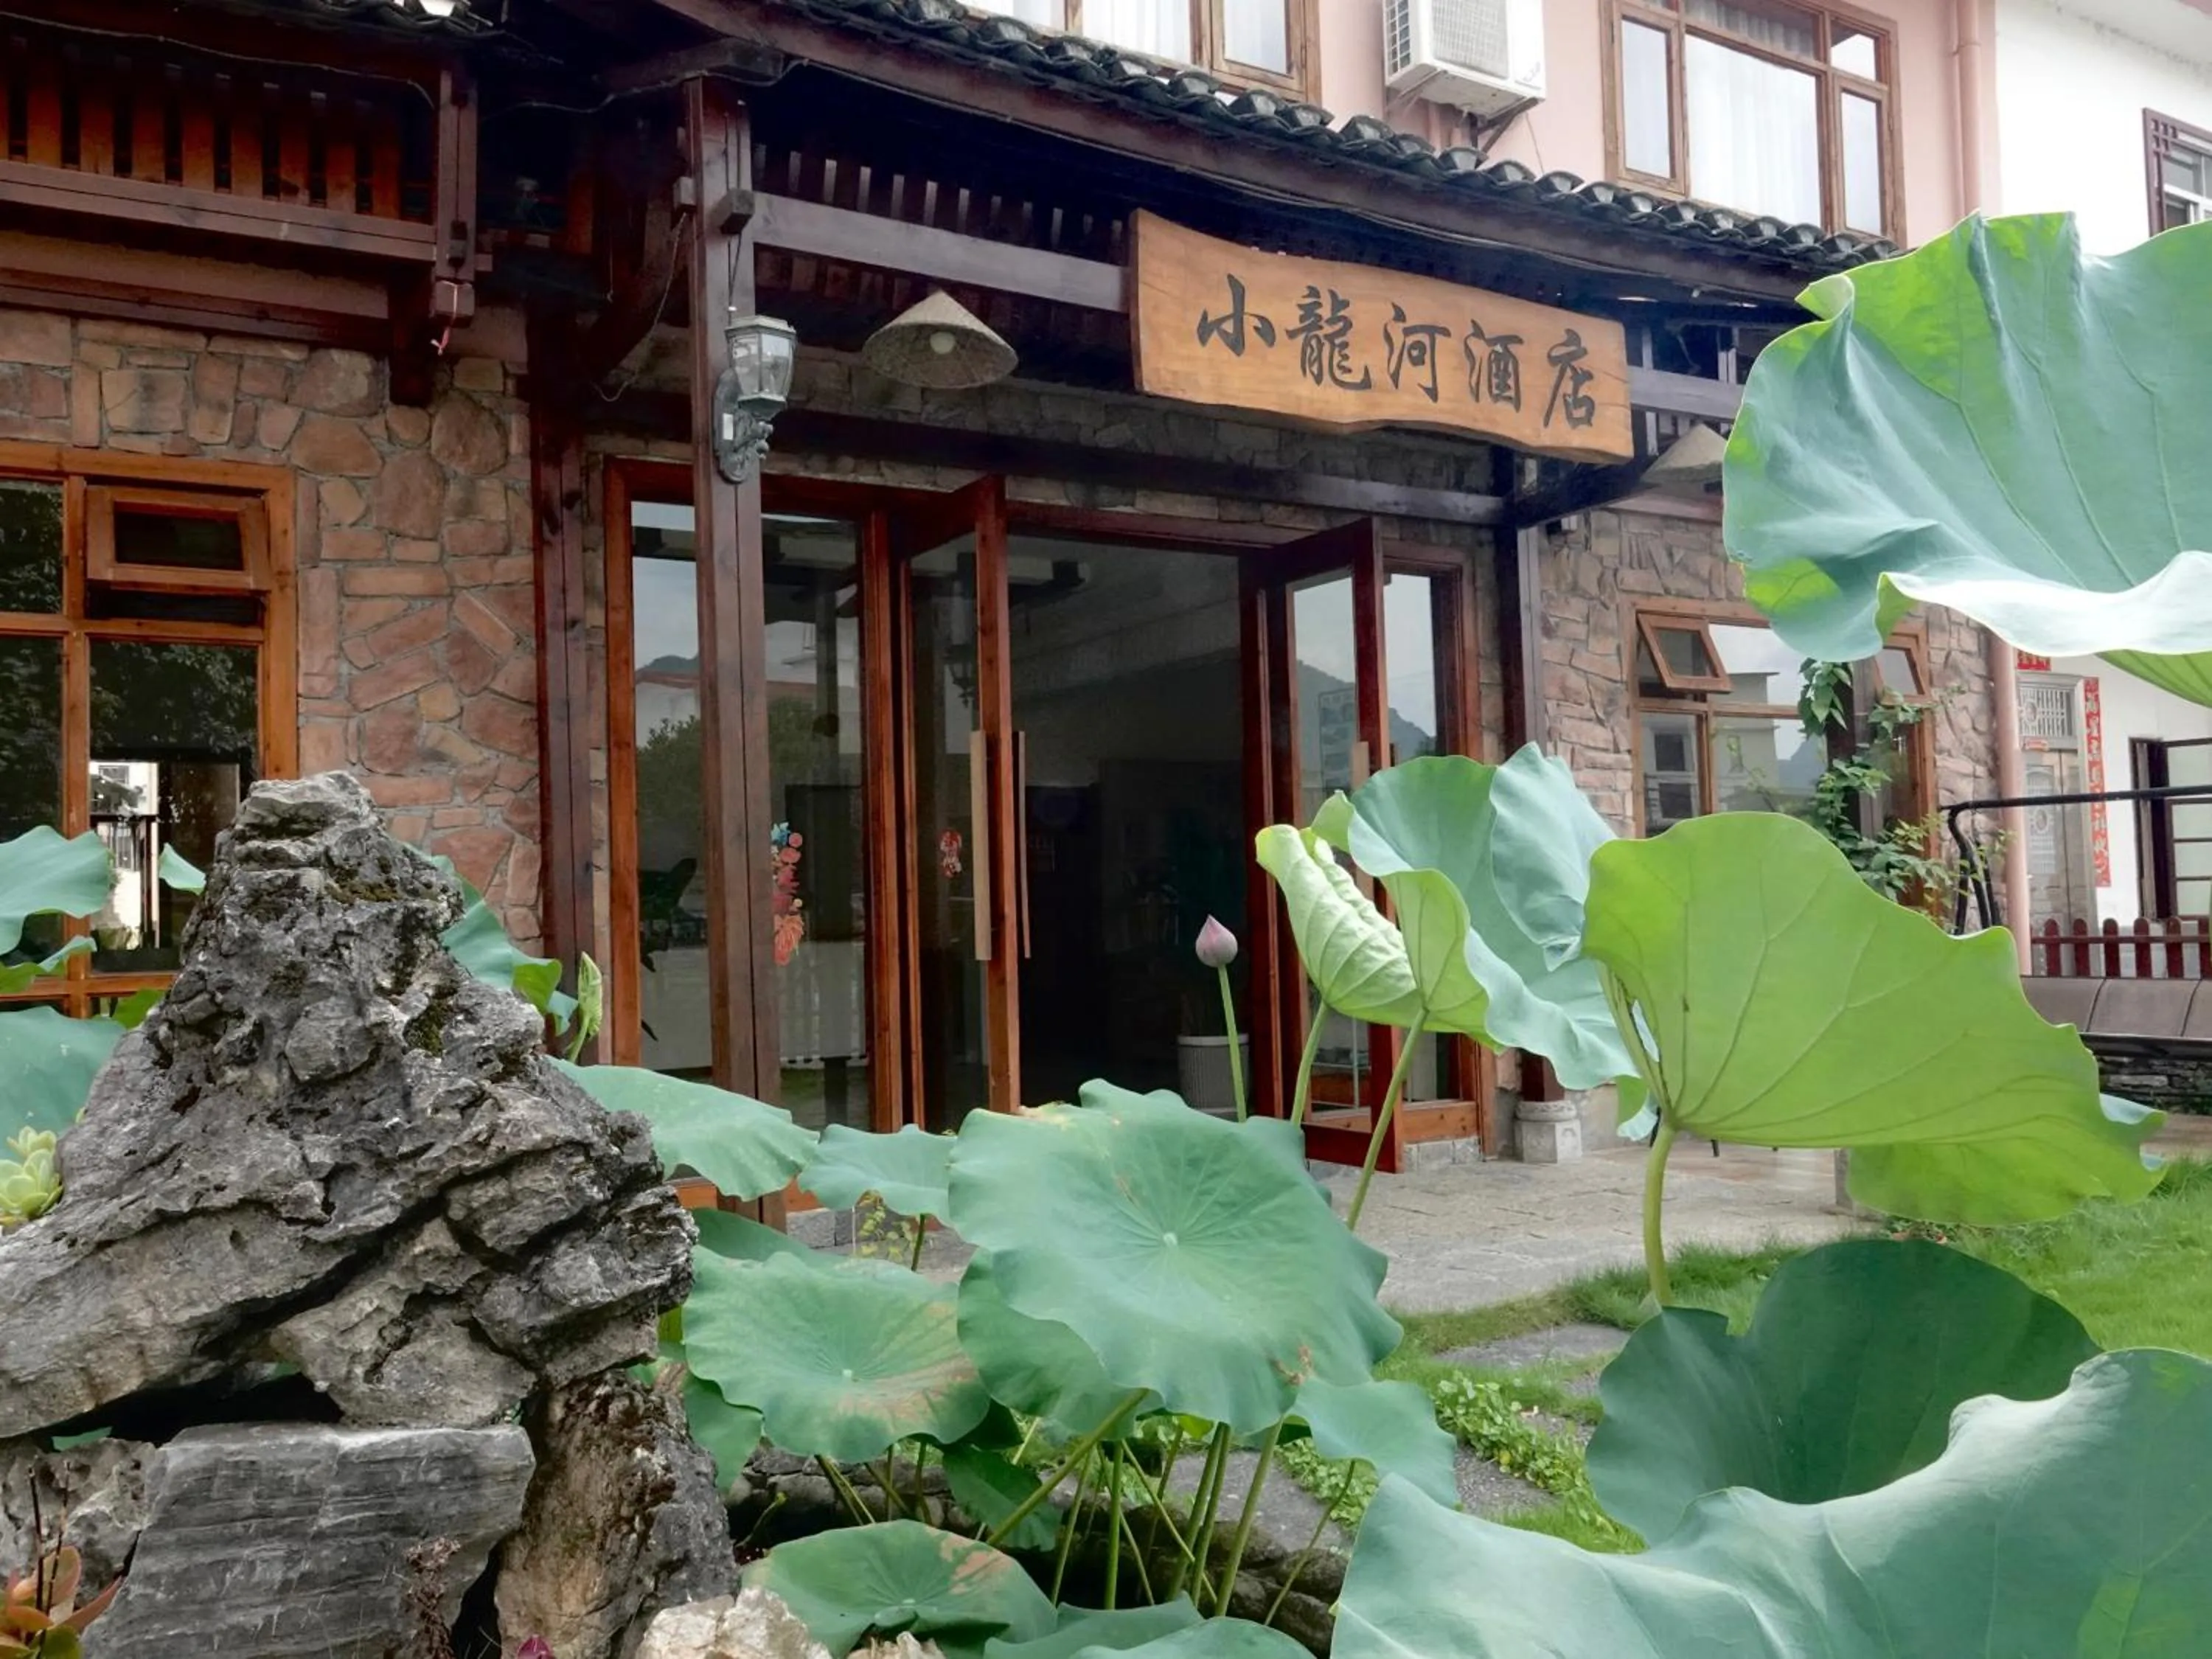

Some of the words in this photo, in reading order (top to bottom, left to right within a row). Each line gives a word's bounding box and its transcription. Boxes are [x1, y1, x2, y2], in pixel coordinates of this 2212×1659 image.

[1197, 274, 1595, 428] 小龍河酒店
